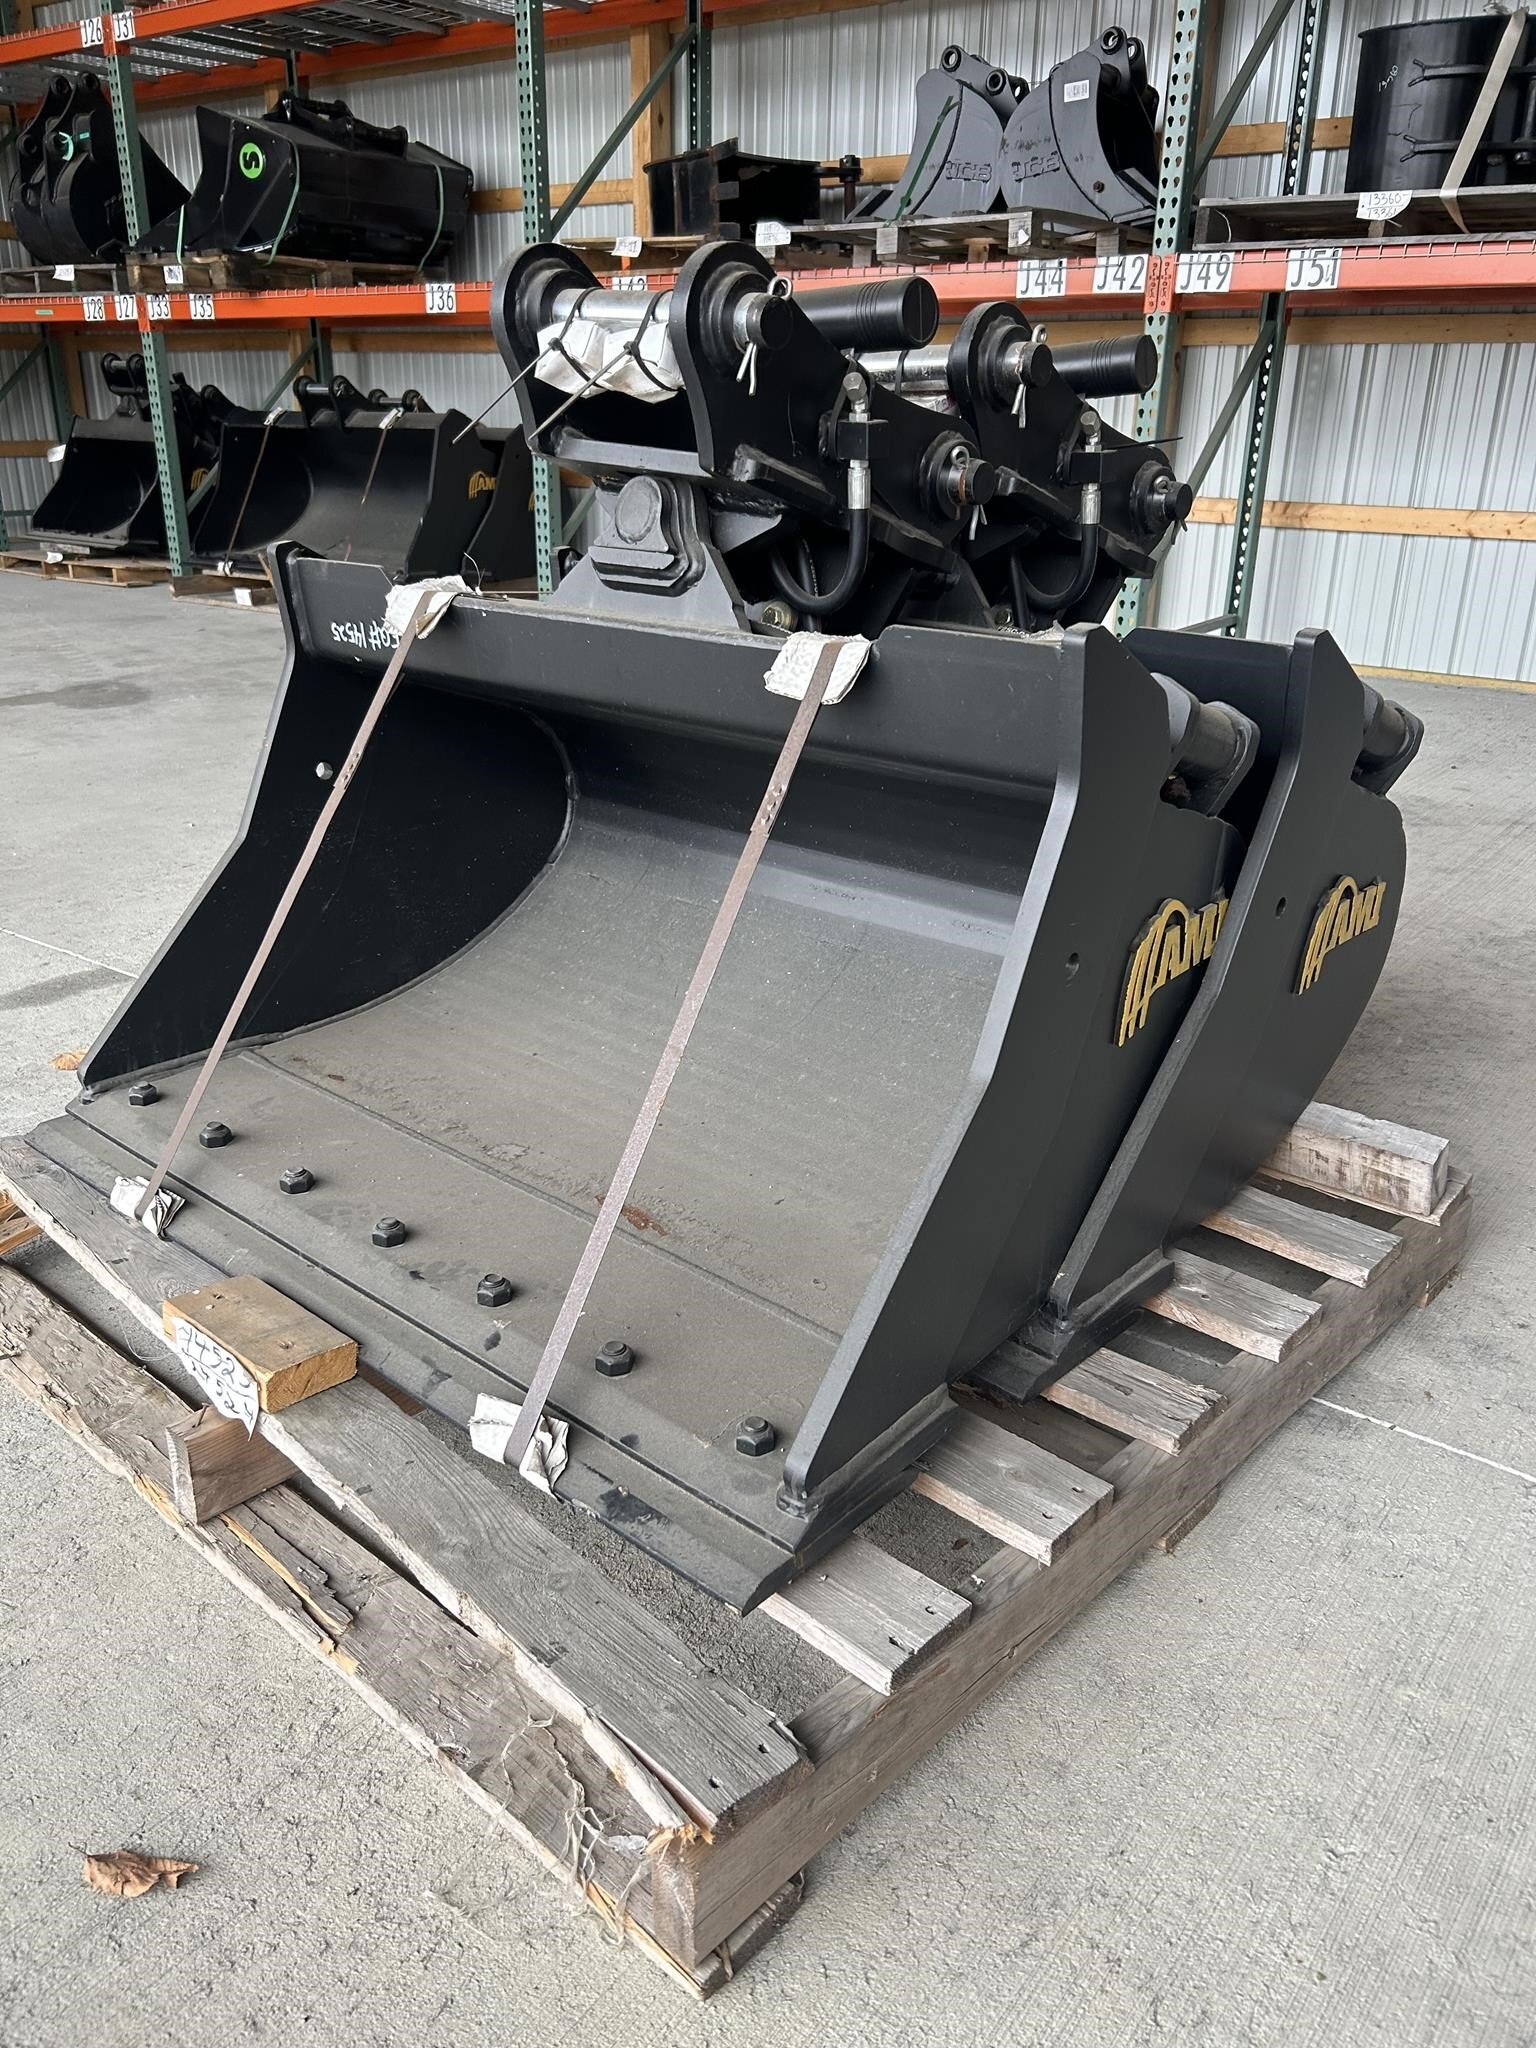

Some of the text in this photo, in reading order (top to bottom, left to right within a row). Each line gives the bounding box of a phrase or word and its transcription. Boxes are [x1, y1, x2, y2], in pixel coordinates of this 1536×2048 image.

[84, 19, 102, 44] J26
[117, 12, 134, 38] J31
[1020, 260, 1064, 295] J44
[1096, 255, 1146, 291] J42
[1180, 253, 1231, 291] J49
[87, 297, 104, 320] J28
[119, 296, 134, 319] J27
[151, 295, 170, 318] J33
[193, 296, 213, 318] J35
[429, 285, 454, 311] J36
[469, 470, 496, 499] AM
